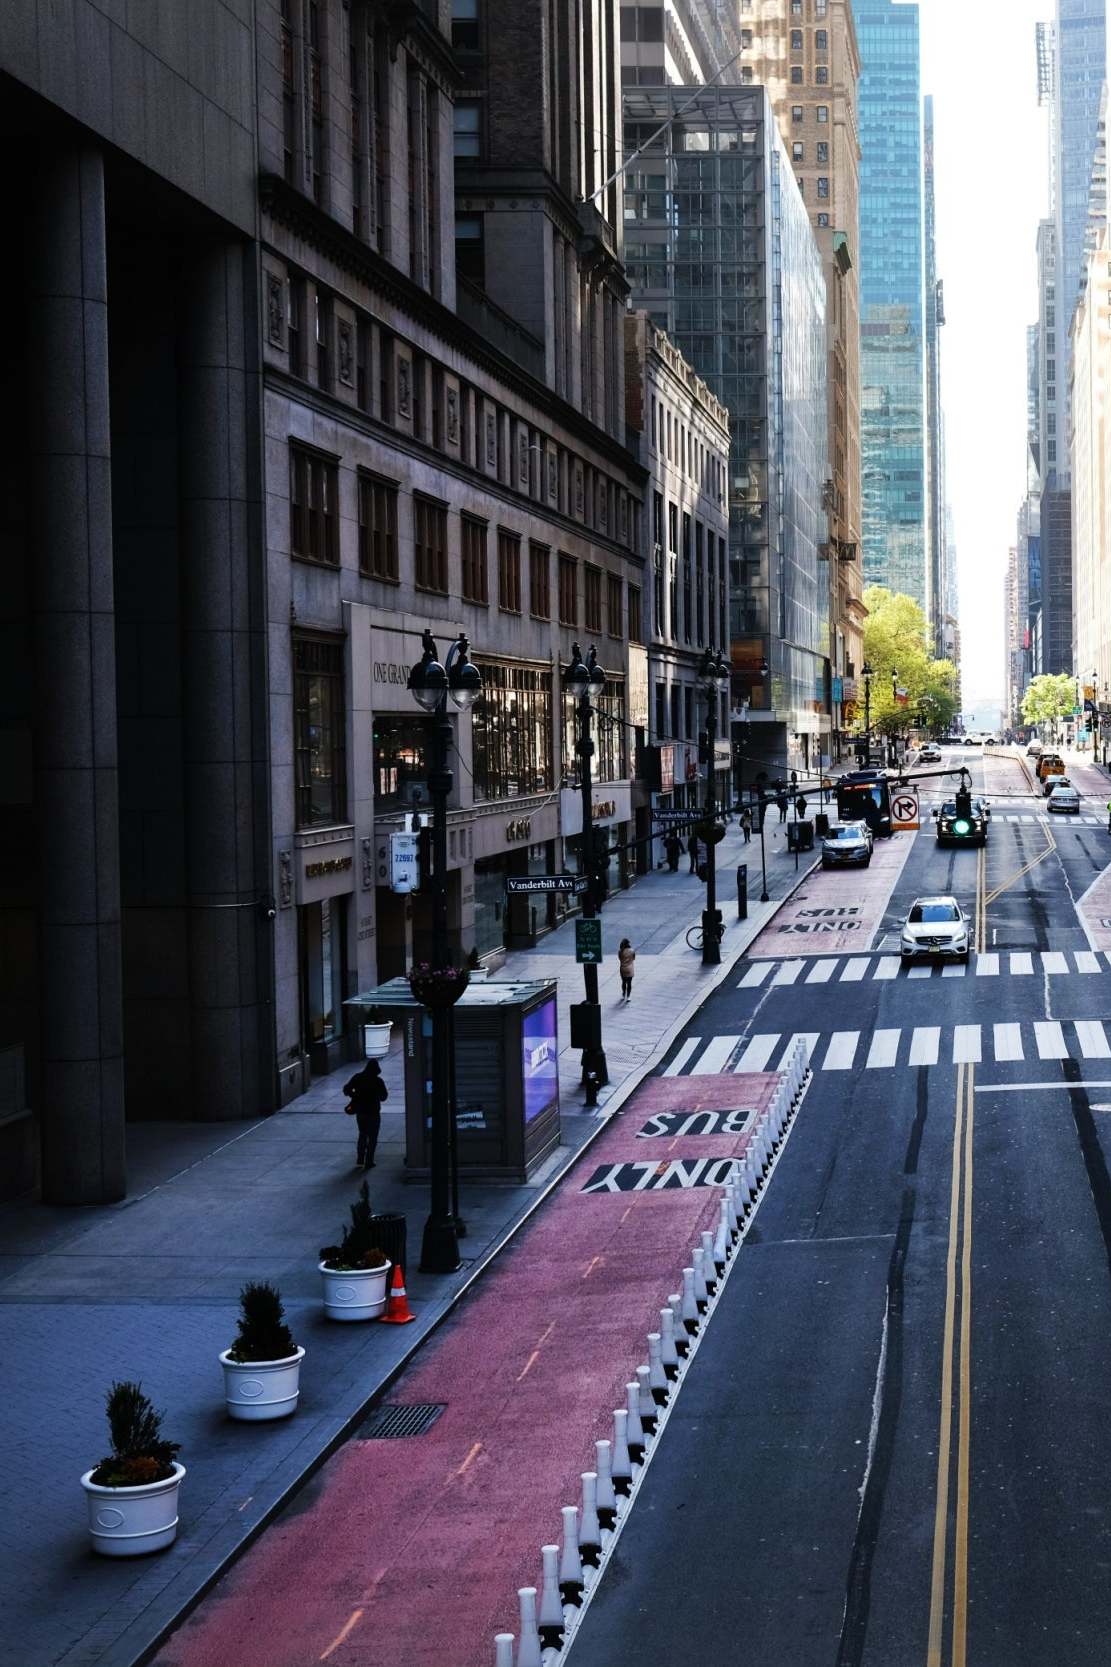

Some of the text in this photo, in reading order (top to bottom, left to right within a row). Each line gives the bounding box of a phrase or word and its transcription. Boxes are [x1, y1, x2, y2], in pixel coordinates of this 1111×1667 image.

[373, 662, 387, 683] ONE
[509, 880, 556, 891] Vanderbilt
[782, 921, 862, 933] ONLY
[636, 1108, 758, 1138] BUS
[578, 1158, 740, 1194] ONLY
